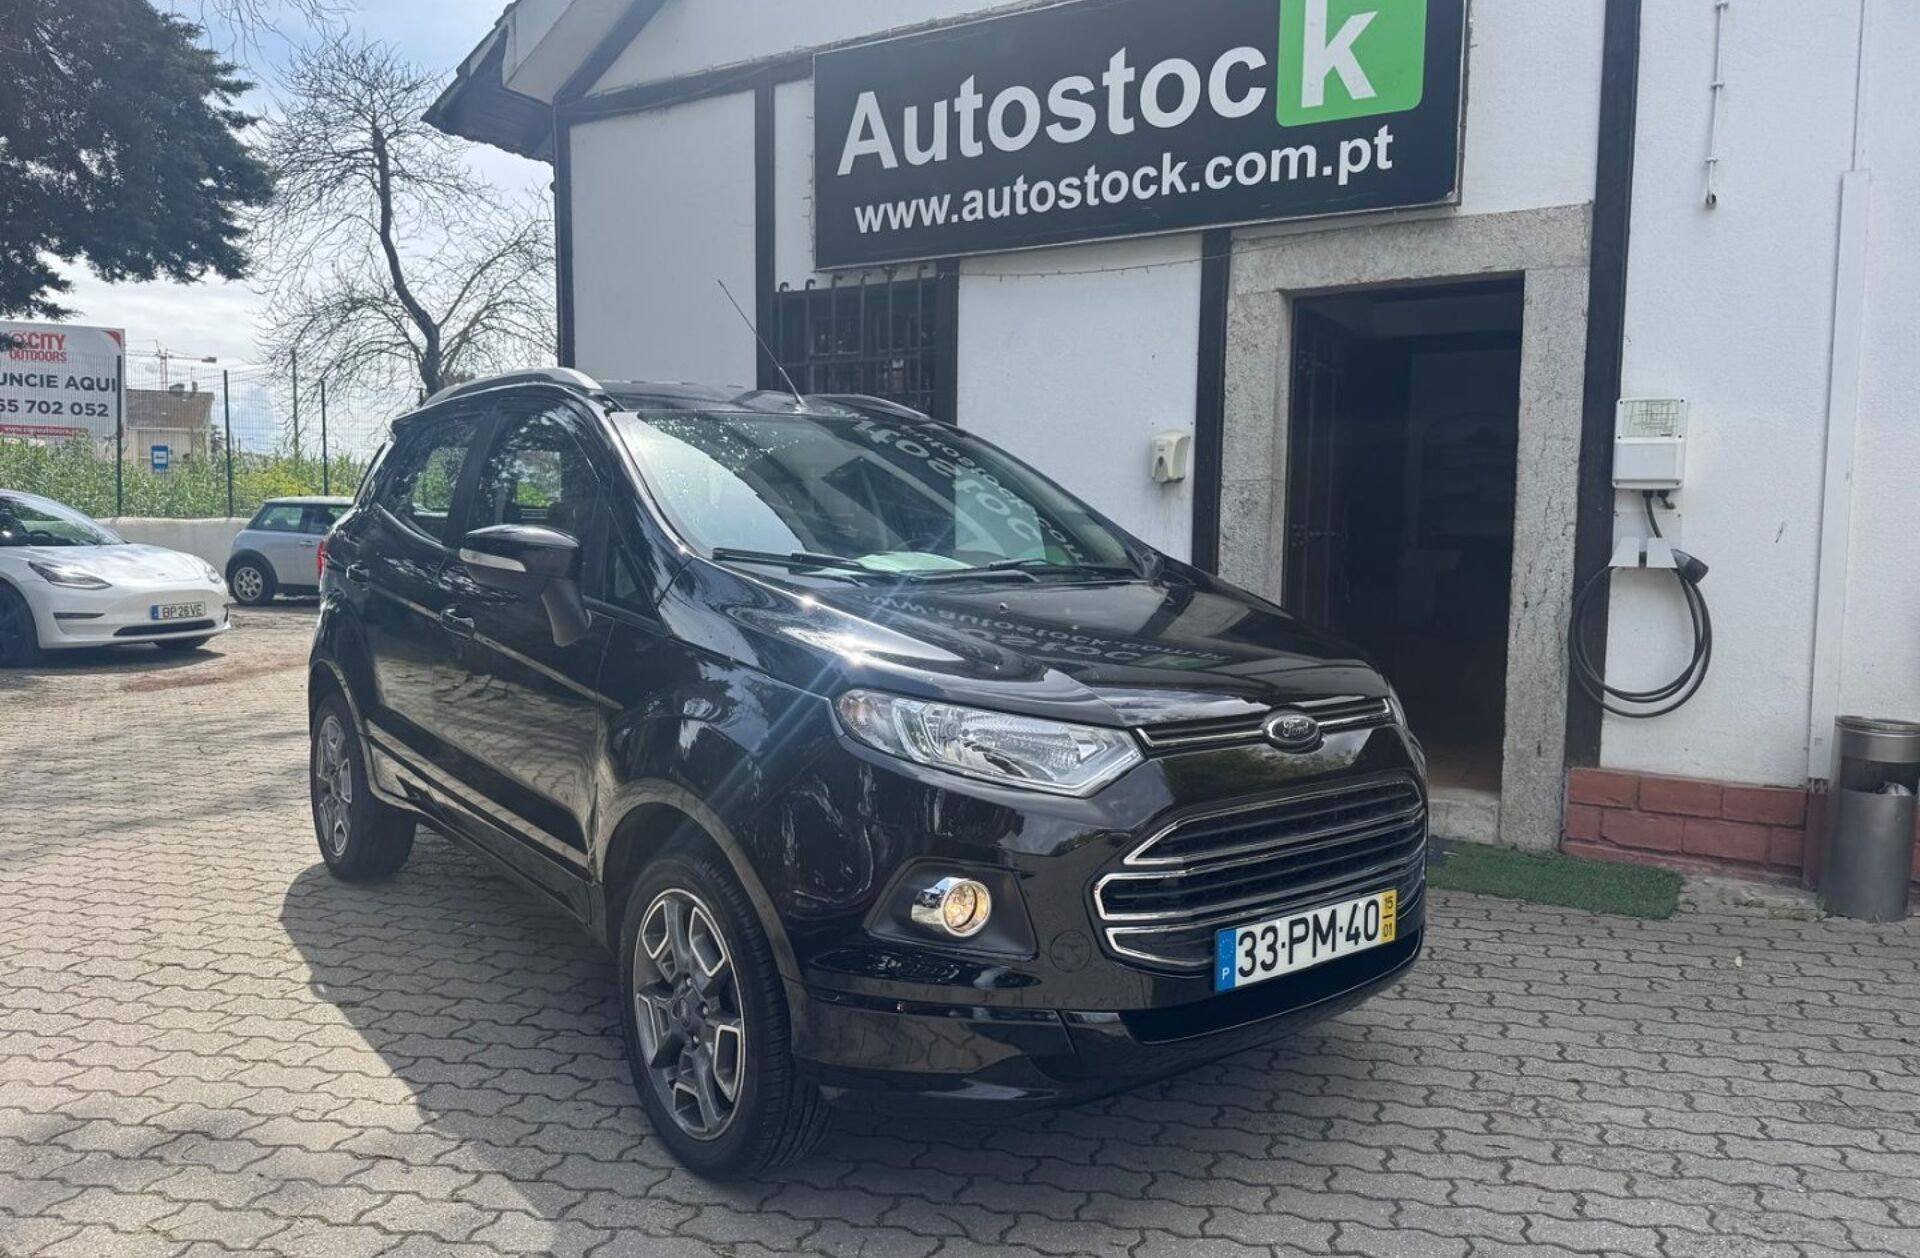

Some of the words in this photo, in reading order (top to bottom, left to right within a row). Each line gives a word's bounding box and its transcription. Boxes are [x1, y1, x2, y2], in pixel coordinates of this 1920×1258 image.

[836, 0, 1378, 176] Autostock
[855, 124, 1394, 234] www.autostock.com.pt
[9, 348, 66, 362] OUTDOORS
[64, 375, 116, 392] AQUI
[24, 399, 63, 415] 702
[70, 402, 109, 417] 052
[1382, 896, 1393, 909] 15
[1383, 924, 1392, 938] 01
[1222, 967, 1230, 980] P
